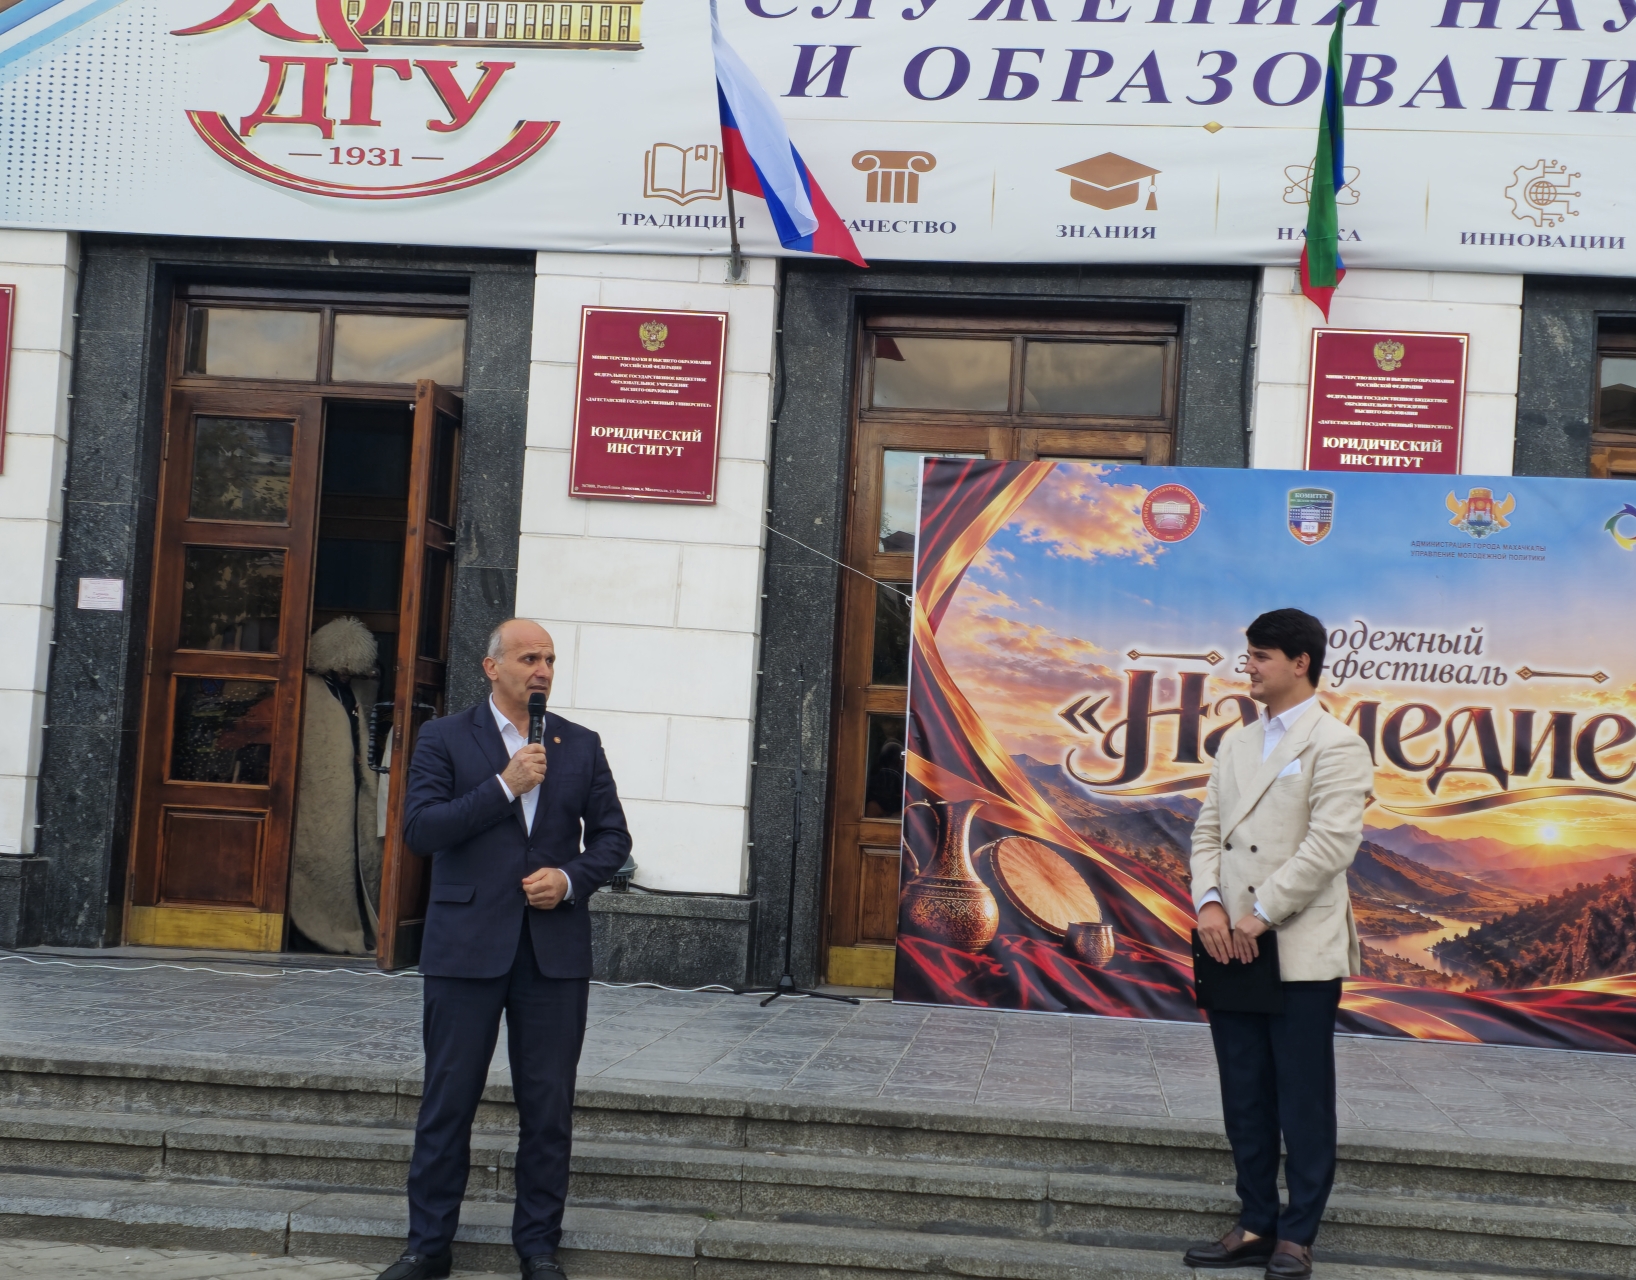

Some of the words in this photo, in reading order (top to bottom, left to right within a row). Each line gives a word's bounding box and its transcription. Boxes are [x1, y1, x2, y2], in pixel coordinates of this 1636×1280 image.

[780, 44, 862, 98] И
[903, 46, 1636, 113] ОБРАЗОВАНИ
[240, 55, 516, 140] ДГУ
[328, 146, 404, 168] 1931
[842, 218, 956, 234] АЧЕСТВО
[1056, 224, 1157, 239] ЗНАНИЯ
[1460, 232, 1626, 250] ИННОВАЦИИ
[591, 426, 702, 443] ЮРИДИЧЕСКИЙ
[607, 442, 684, 456] ИНСТИТУТ
[1322, 437, 1443, 453] ЮРИДИЧЕСКИЙ
[1340, 453, 1424, 468] ИНСТИТУТ
[1329, 620, 1483, 655] одежный
[1058, 670, 1636, 795] «Наледие
